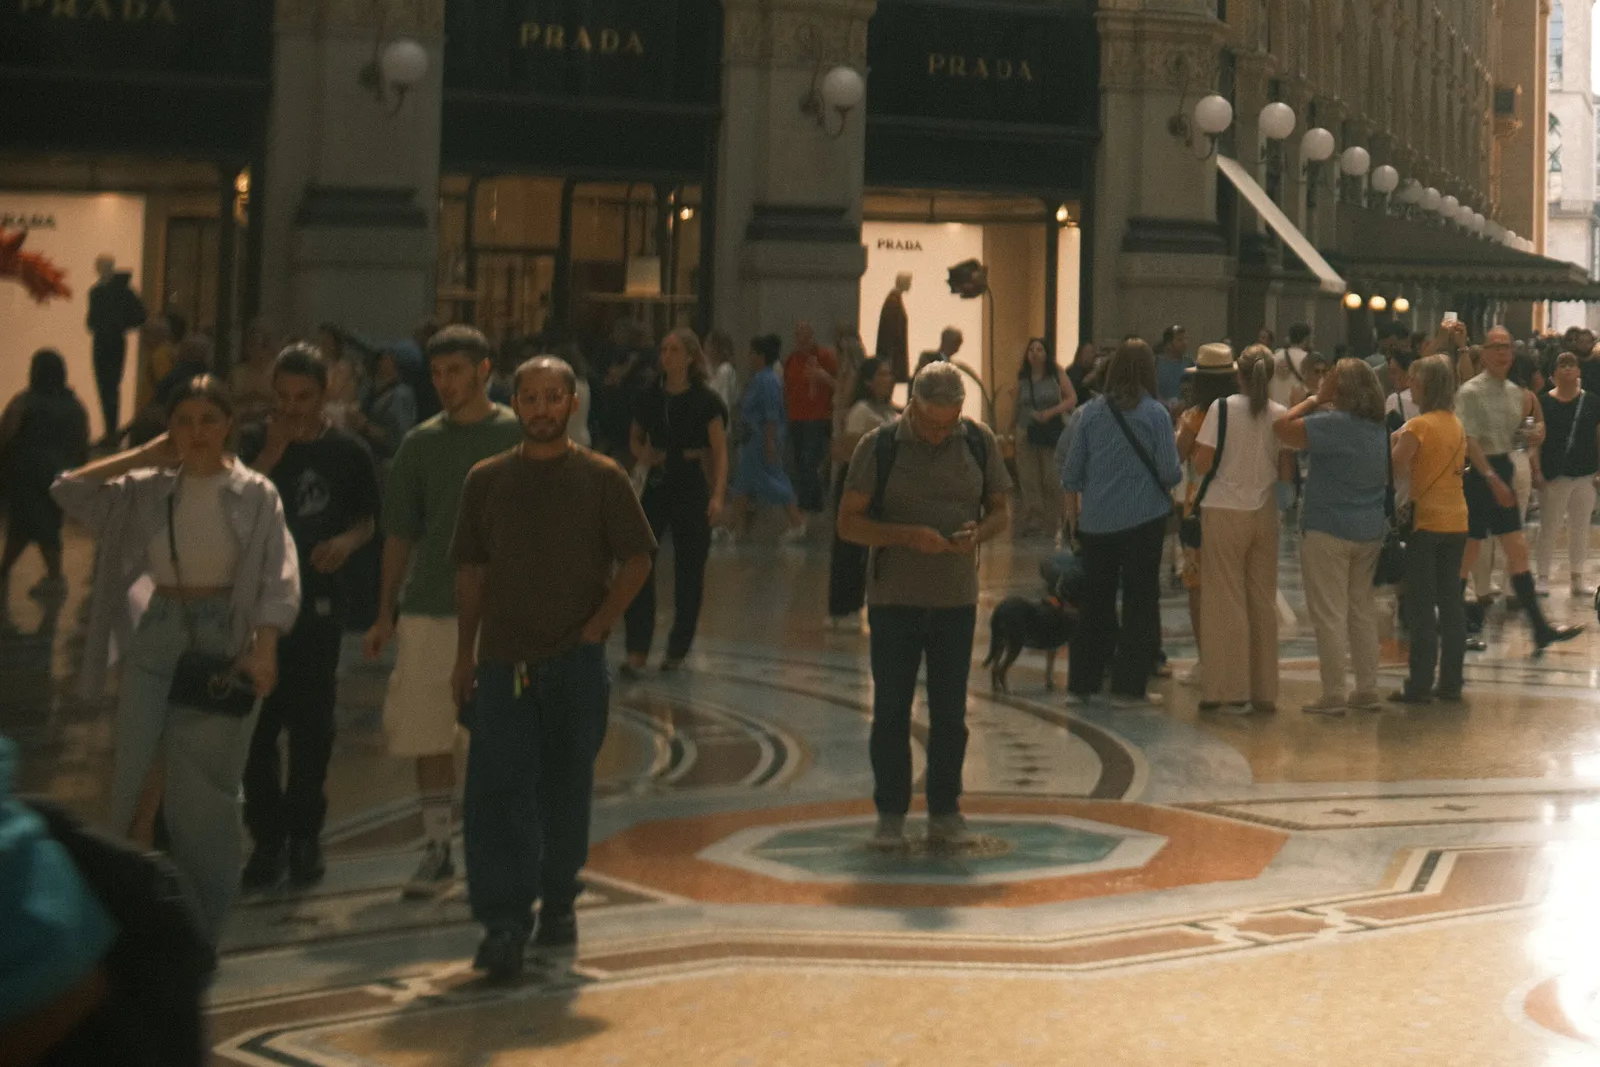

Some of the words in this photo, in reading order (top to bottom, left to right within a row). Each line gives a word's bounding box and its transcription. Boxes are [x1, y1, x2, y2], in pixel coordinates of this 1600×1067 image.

[520, 22, 645, 55] PRADA
[928, 52, 1033, 82] PRADA
[877, 238, 923, 251] PRADA
